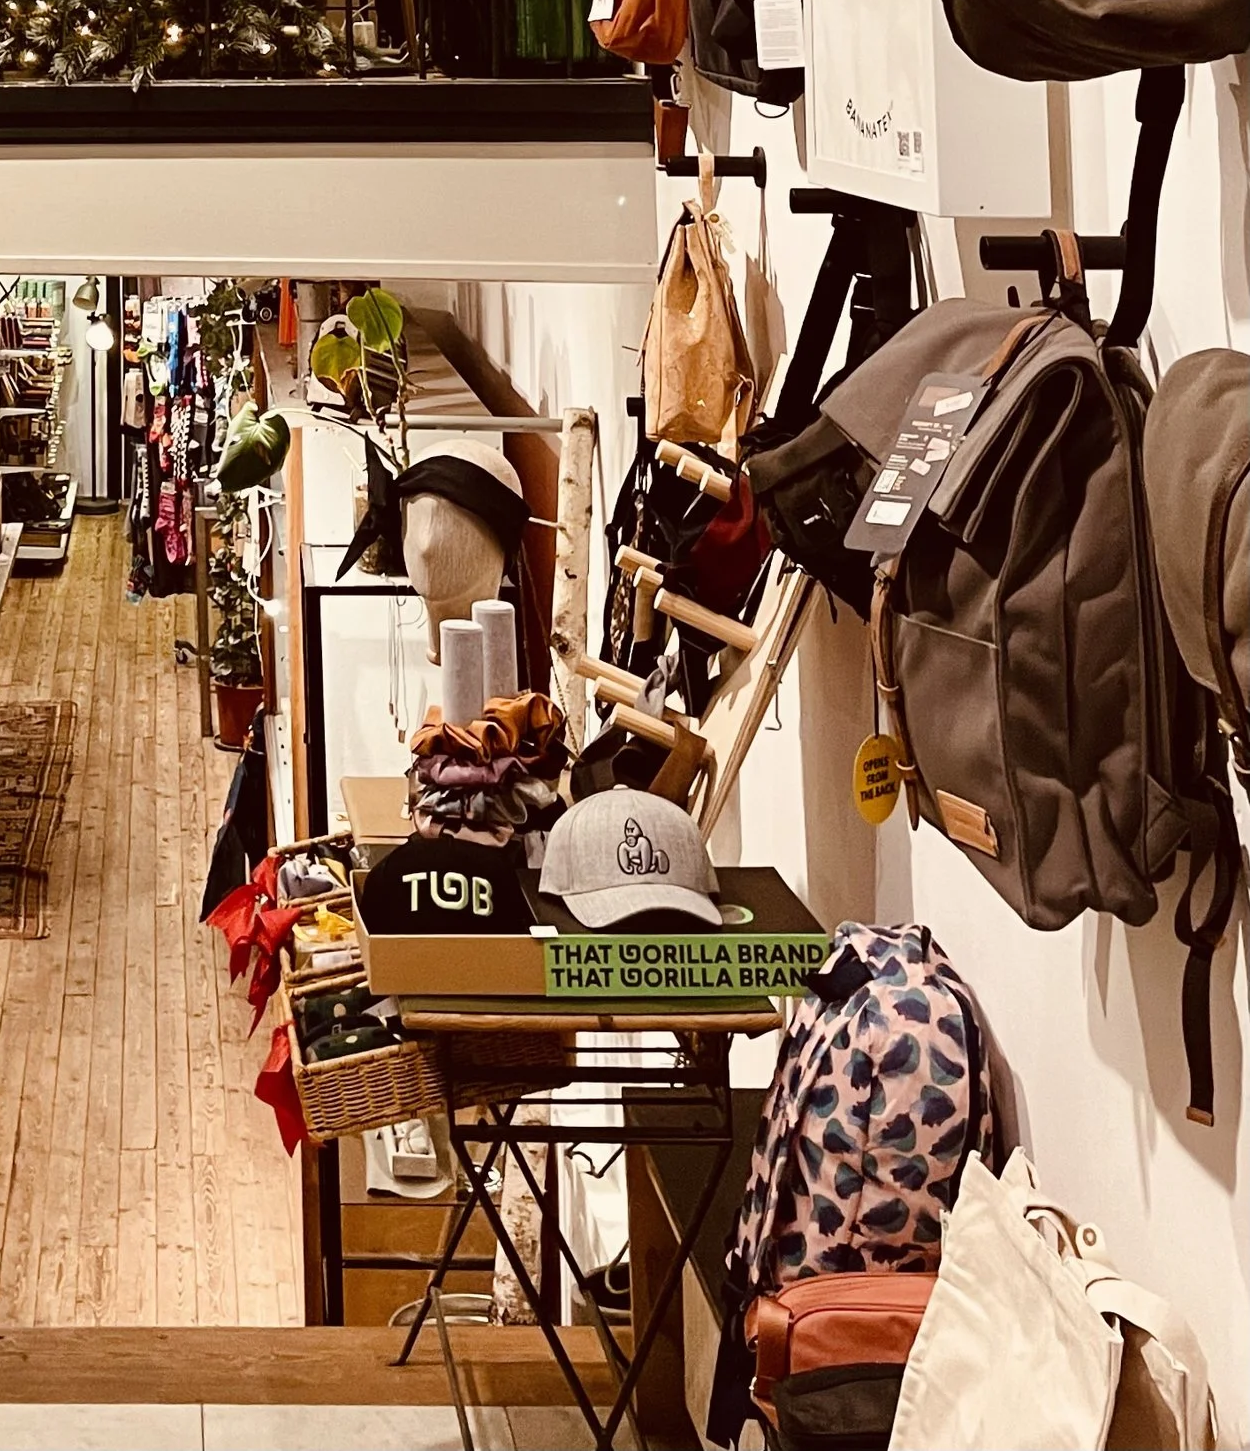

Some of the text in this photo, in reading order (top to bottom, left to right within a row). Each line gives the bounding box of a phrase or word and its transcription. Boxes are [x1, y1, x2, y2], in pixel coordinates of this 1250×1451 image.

[863, 756, 889, 772] OPENS
[866, 770, 888, 785] FROM
[550, 944, 824, 965] THAT GORILLA BRAND
[551, 966, 820, 988] THAT GORILLA BRAN
